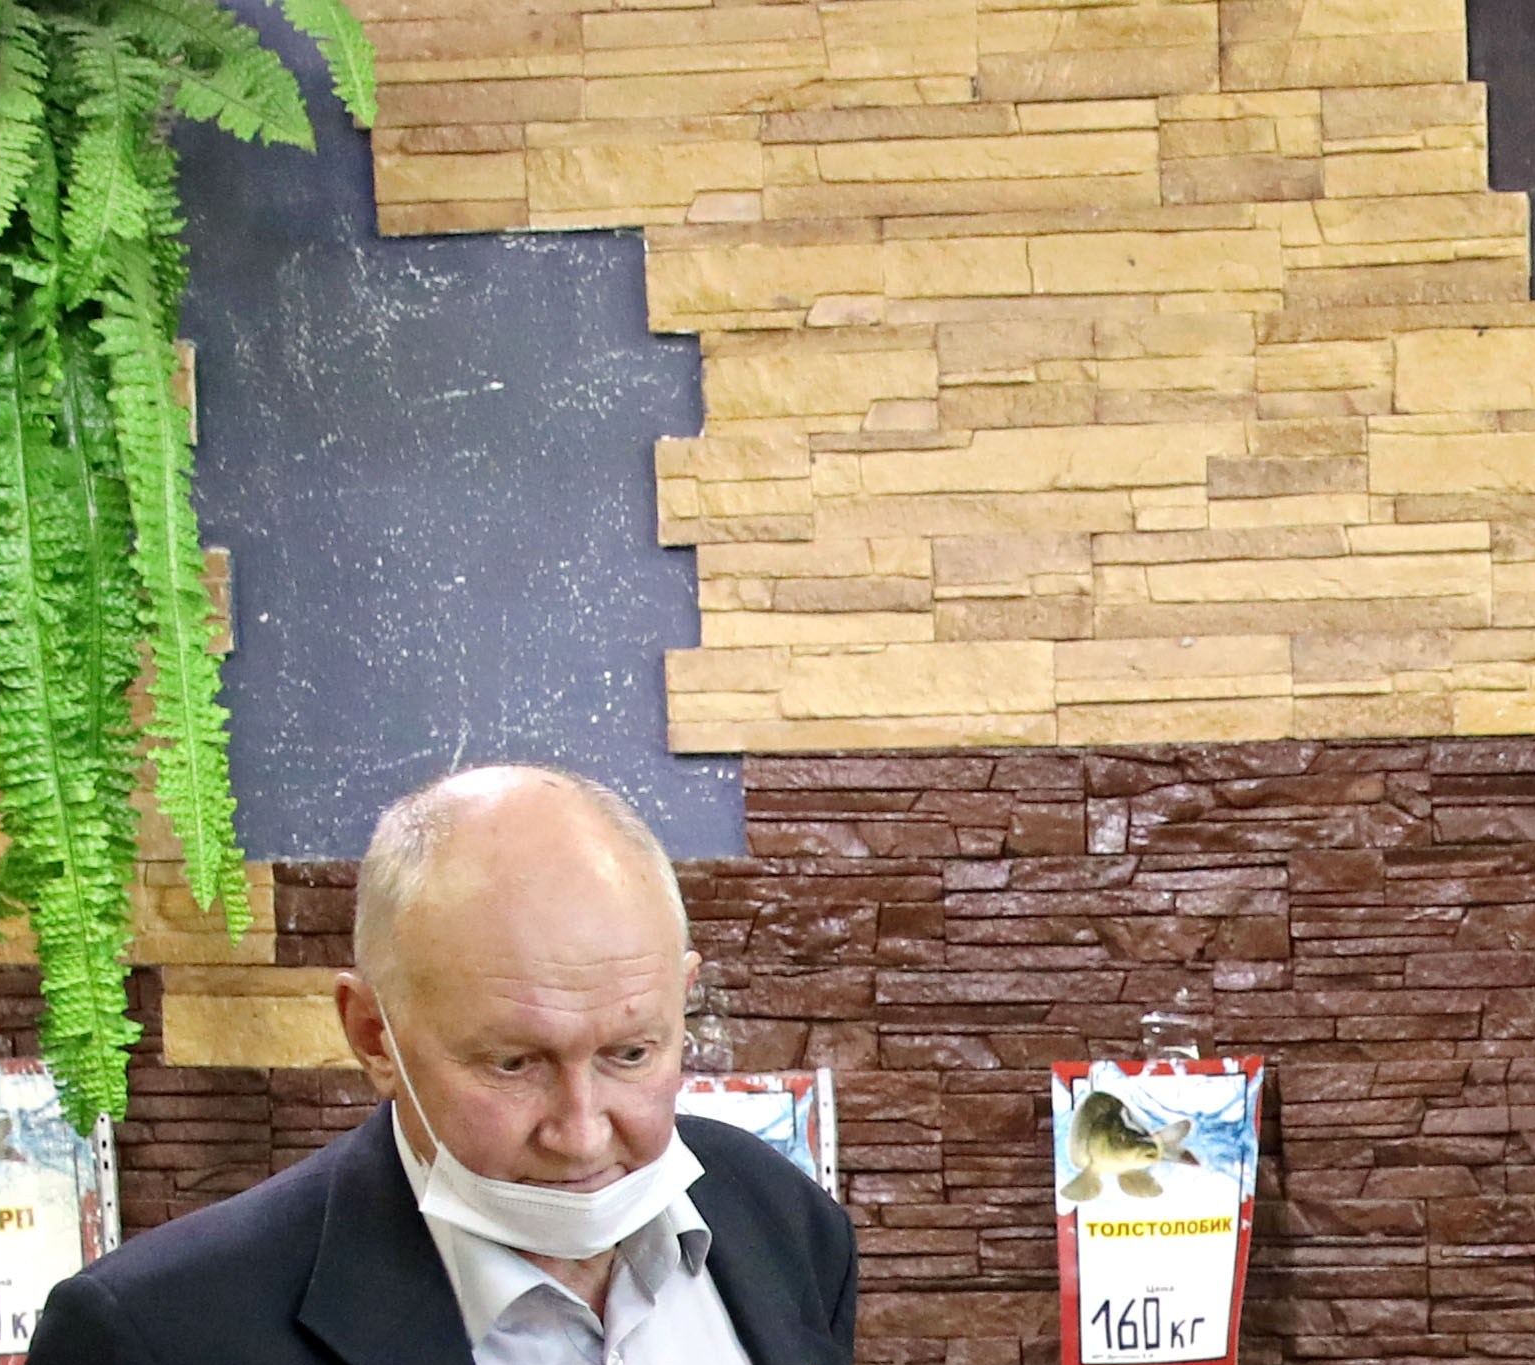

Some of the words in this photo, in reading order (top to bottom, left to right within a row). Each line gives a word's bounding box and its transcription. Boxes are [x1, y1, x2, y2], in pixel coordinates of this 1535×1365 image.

[1086, 1217, 1233, 1238] ТОЛСТОЛОБИК
[1091, 1297, 1160, 1350] 160
[1170, 1317, 1205, 1349] кг
